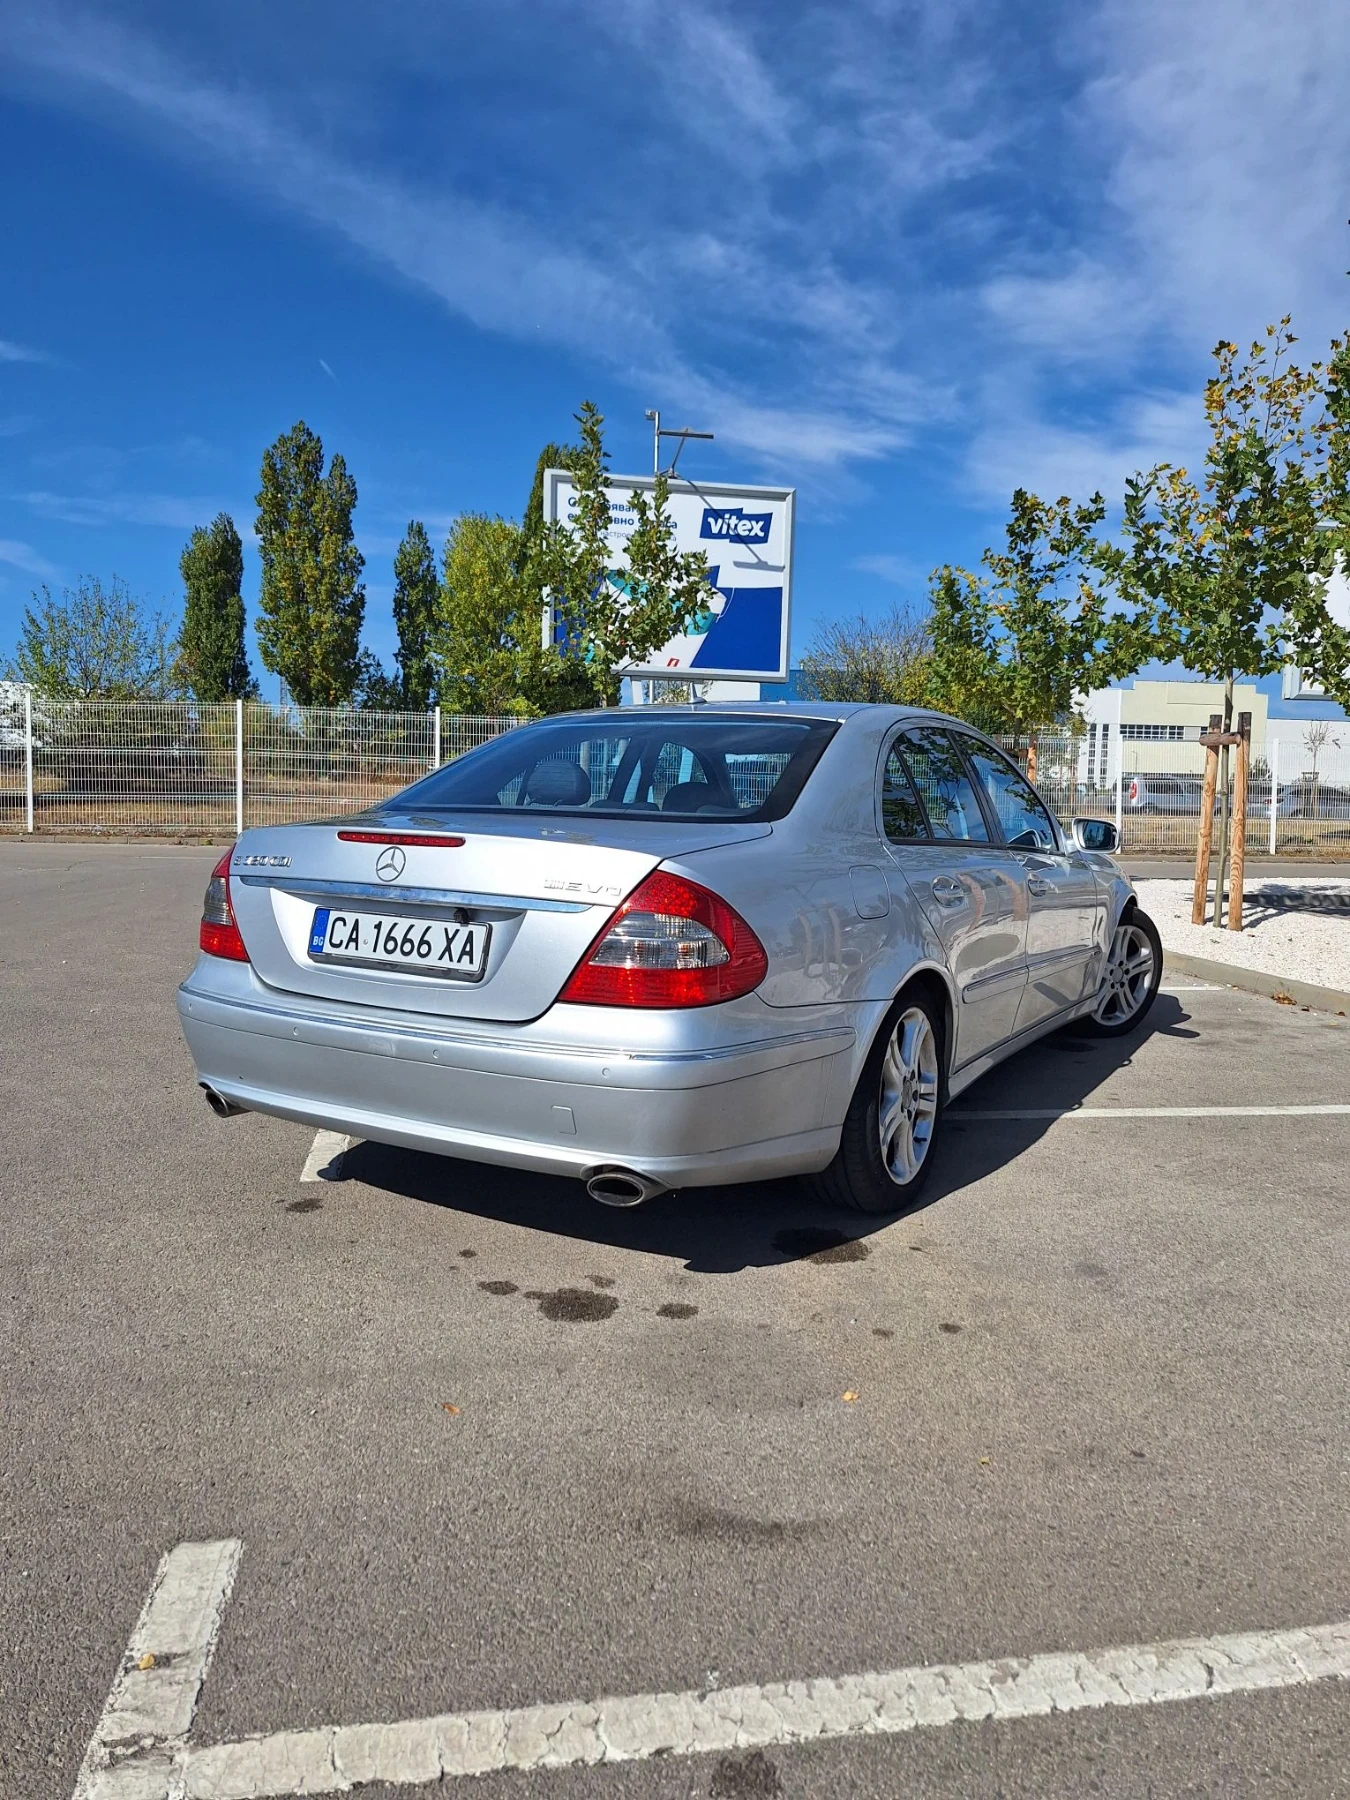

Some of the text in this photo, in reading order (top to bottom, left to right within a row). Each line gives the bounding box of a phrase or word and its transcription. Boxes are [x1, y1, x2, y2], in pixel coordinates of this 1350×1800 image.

[707, 513, 765, 537] vitex
[312, 935, 324, 946] BG
[328, 916, 474, 965] CA 1666 XA
